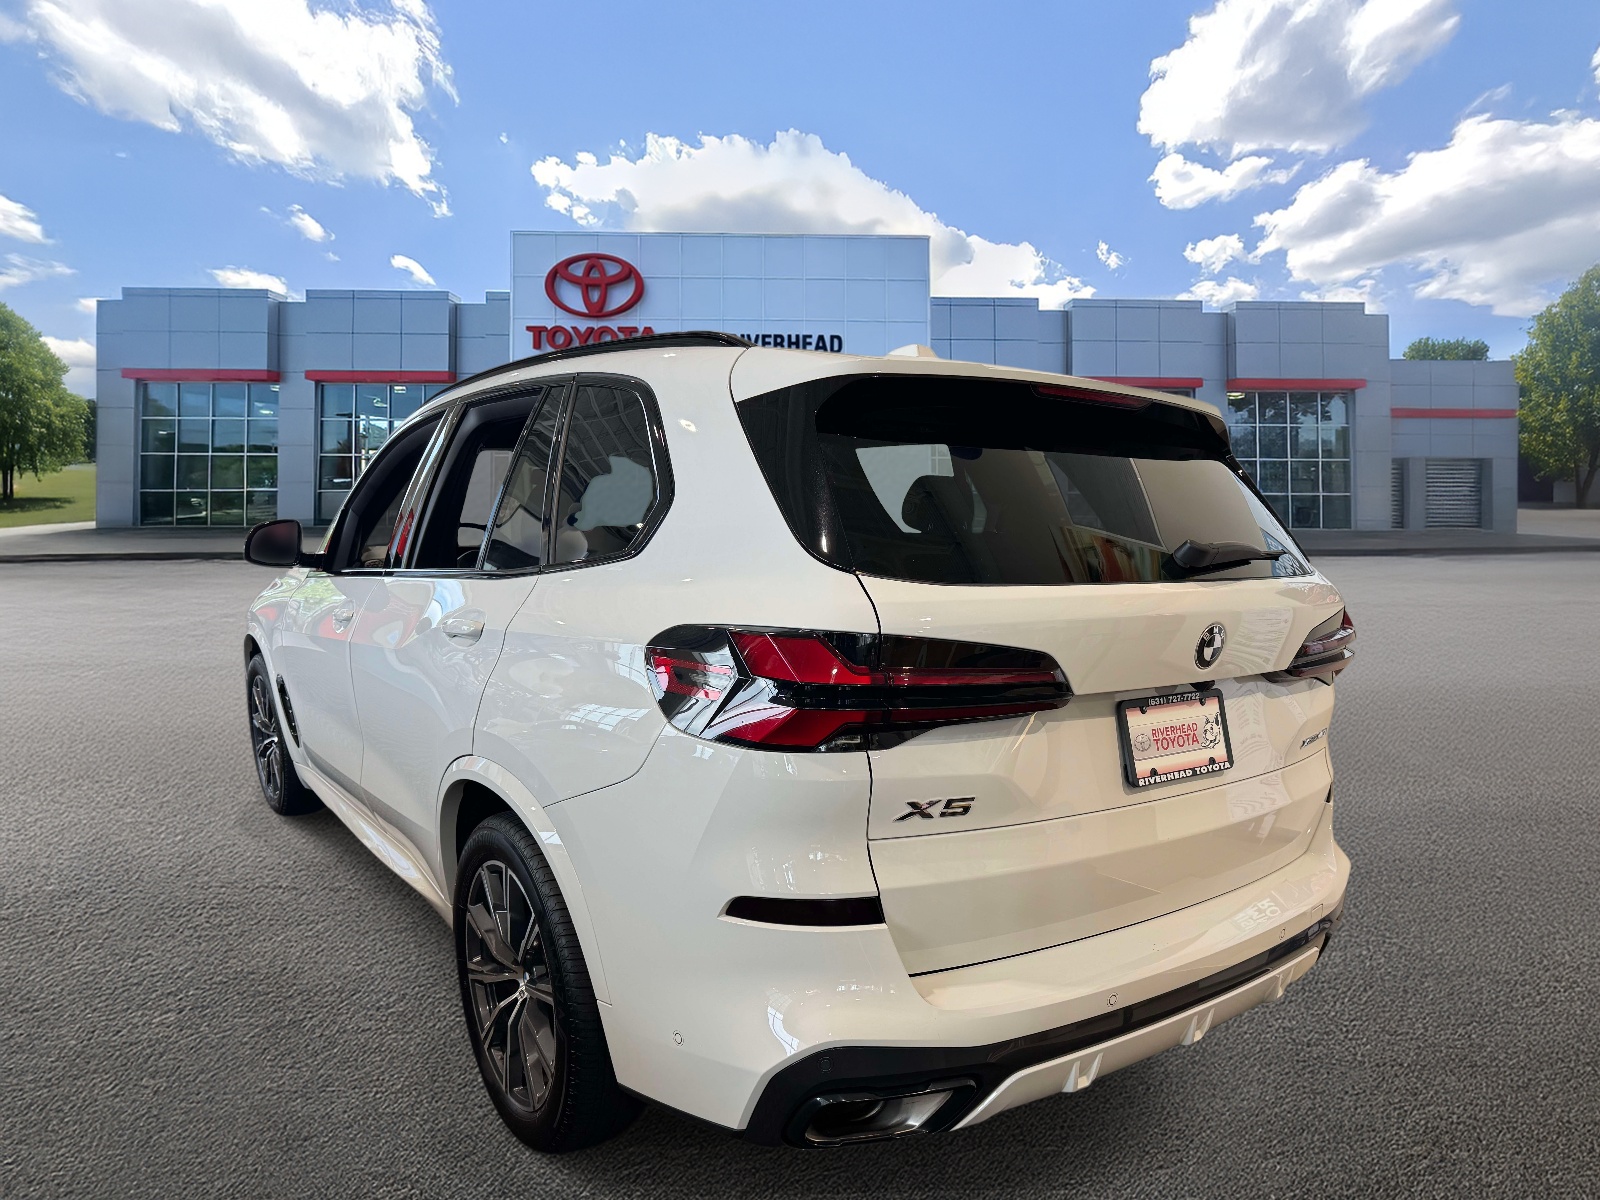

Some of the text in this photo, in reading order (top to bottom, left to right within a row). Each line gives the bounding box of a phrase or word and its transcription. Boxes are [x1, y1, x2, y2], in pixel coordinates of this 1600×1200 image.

[740, 333, 843, 353] VERHEAD
[1168, 692, 1200, 703] 727-7722
[1151, 722, 1198, 739] RIVERHEAD
[1153, 732, 1200, 751] TOYOTA
[1138, 761, 1231, 787] RIVERHEAD TOYOTA
[893, 796, 976, 822] X5
